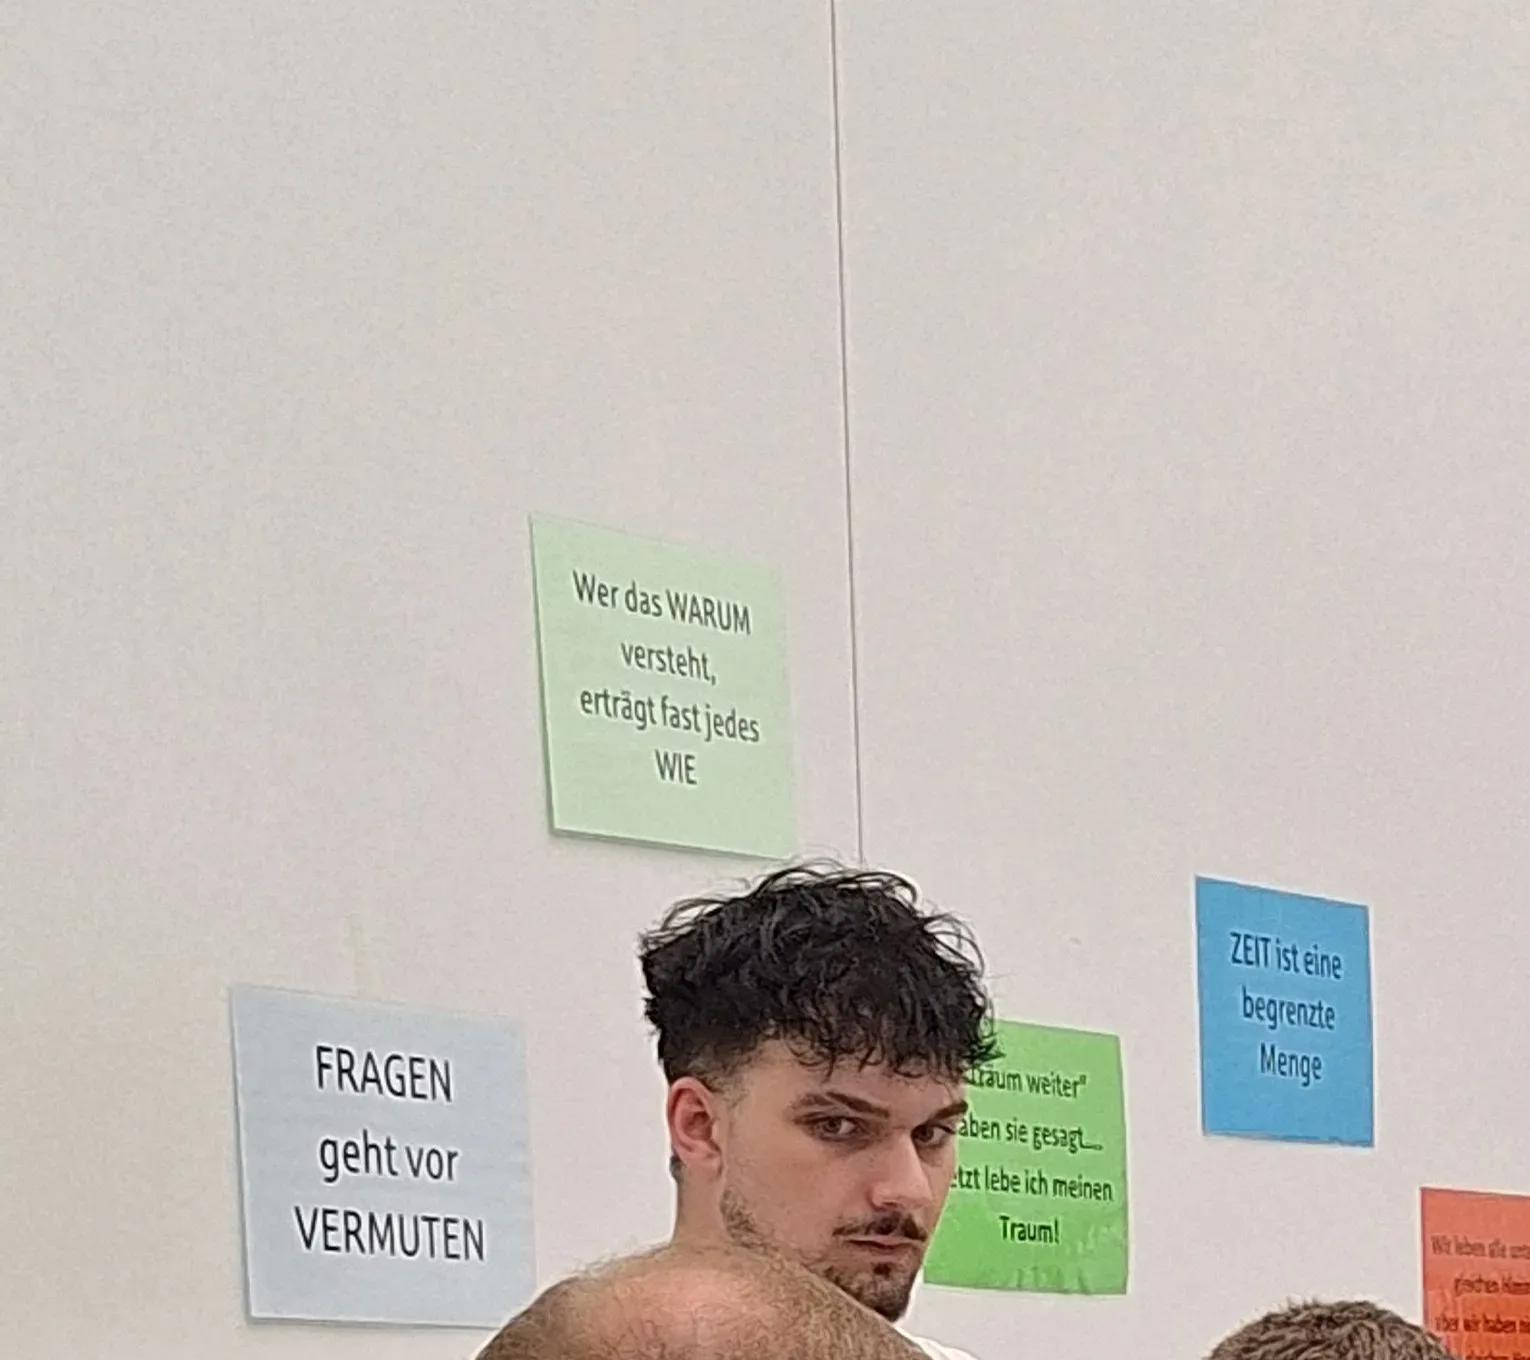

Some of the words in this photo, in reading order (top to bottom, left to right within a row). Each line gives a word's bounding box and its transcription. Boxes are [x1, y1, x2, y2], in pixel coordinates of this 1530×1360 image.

[572, 569, 619, 609] Wer
[625, 580, 662, 617] das
[665, 588, 751, 636] WARUM
[621, 641, 717, 686] versteht,
[580, 688, 656, 731] erträgt
[661, 695, 700, 733] fast
[704, 704, 760, 742] jedes
[655, 749, 697, 785] WIE
[1229, 931, 1271, 968] ZEIT
[1276, 938, 1299, 973] ist
[1304, 944, 1342, 979] eine
[1242, 984, 1335, 1031] begrenzte
[316, 1045, 453, 1102] FRAGEN
[1260, 1042, 1322, 1087] Menge
[958, 1112, 1000, 1140] aben
[1006, 1117, 1028, 1142] sie
[319, 1128, 399, 1183] geht
[405, 1147, 459, 1181] vor
[985, 1164, 1021, 1193] lebe
[1024, 1168, 1048, 1195] ich
[1053, 1173, 1113, 1201] meinen
[294, 1205, 485, 1261] VERMUTEN
[999, 1215, 1060, 1243] Traum!
[1431, 1235, 1451, 1255] Wir
[1455, 1235, 1485, 1257] leben
[1489, 1238, 1506, 1259] alle
[1464, 1314, 1481, 1332] wir
[1483, 1313, 1516, 1333] haben
